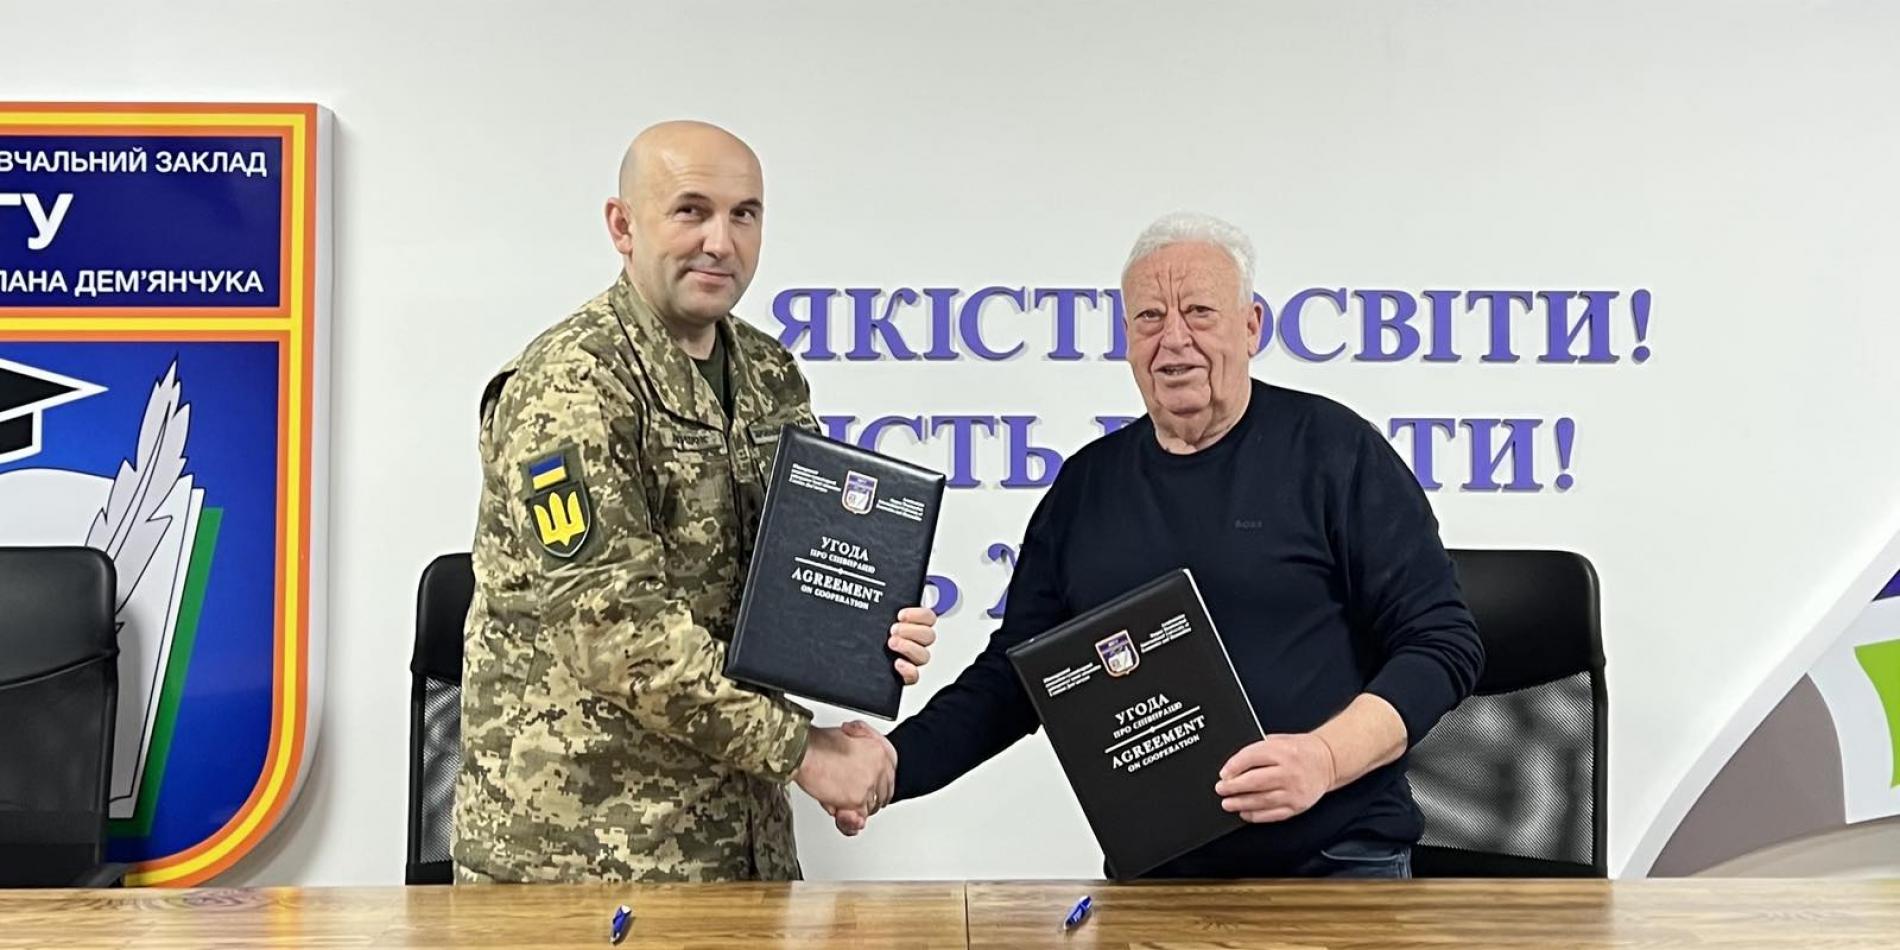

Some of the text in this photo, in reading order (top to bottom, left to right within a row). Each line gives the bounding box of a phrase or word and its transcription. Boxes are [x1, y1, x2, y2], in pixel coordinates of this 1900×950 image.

[155, 151, 267, 177] ЗАКЛАД
[810, 548, 827, 560] ПРО
[821, 536, 869, 562] УГОДА
[791, 567, 884, 603] AGREEMENT
[800, 584, 870, 610] ON COOPERATION
[1114, 693, 1170, 725] УГОДА
[1112, 714, 1205, 769] AGREEMENT
[1113, 725, 1132, 739] ПРО
[1127, 734, 1200, 773] ON COOPERATION
